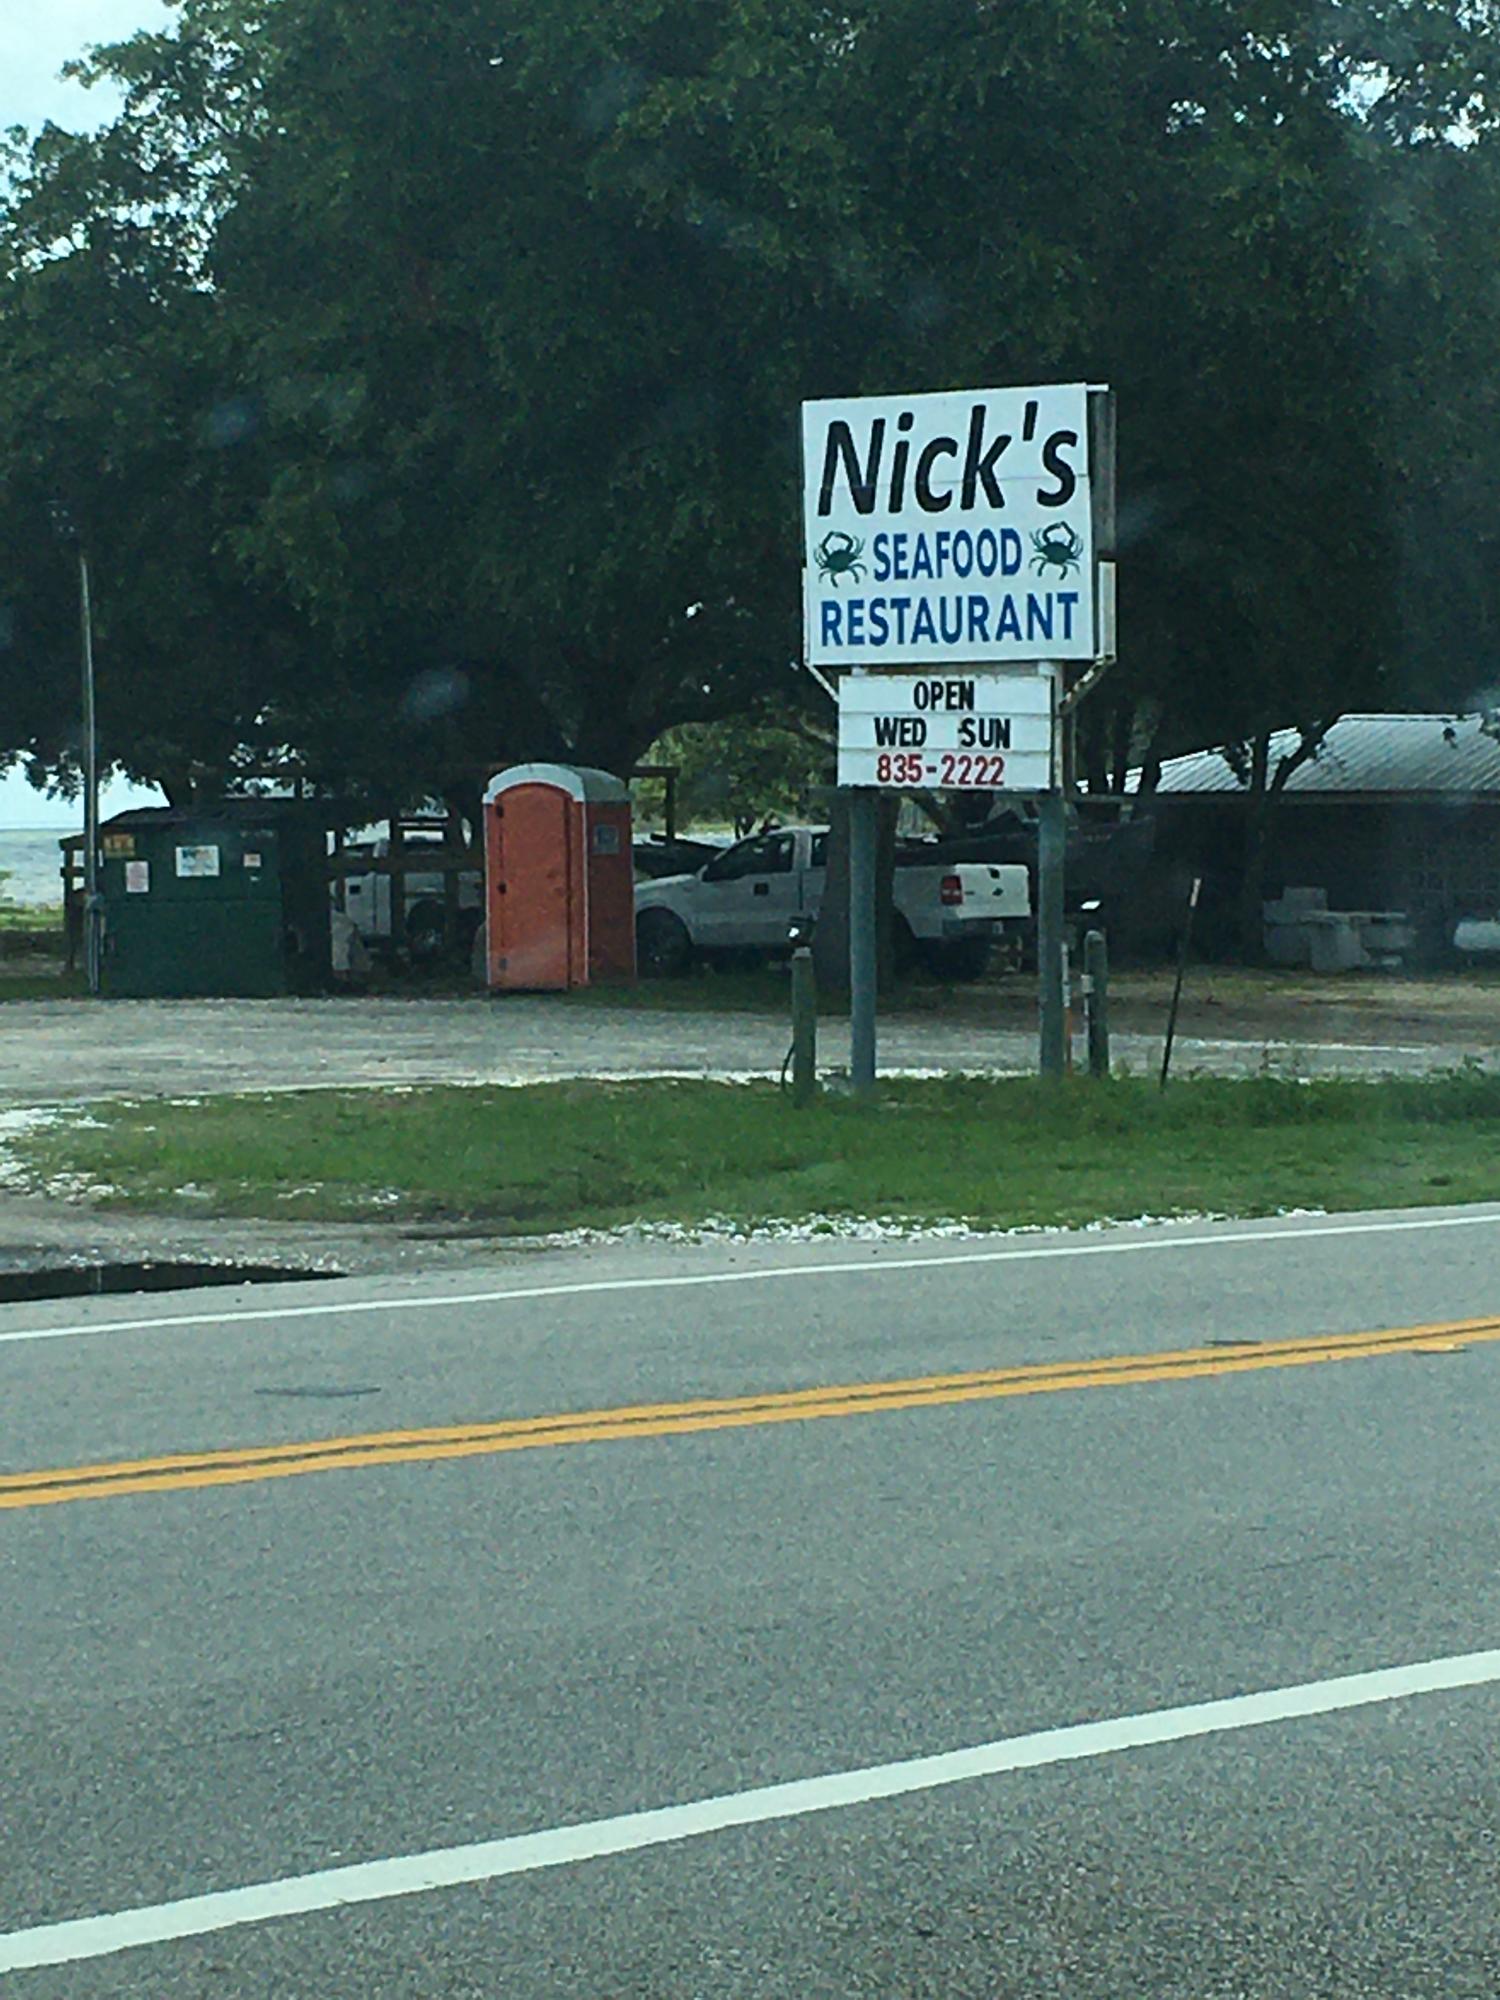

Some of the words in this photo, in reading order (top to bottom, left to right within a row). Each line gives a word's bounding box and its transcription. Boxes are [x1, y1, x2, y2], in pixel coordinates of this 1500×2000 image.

[817, 400, 1078, 516] Nick's
[873, 527, 1023, 581] SEAFOOD
[821, 592, 1079, 646] RESTAURANT
[913, 681, 975, 711] OPEN
[874, 717, 927, 747] WED
[877, 753, 1005, 786] 835-2222
